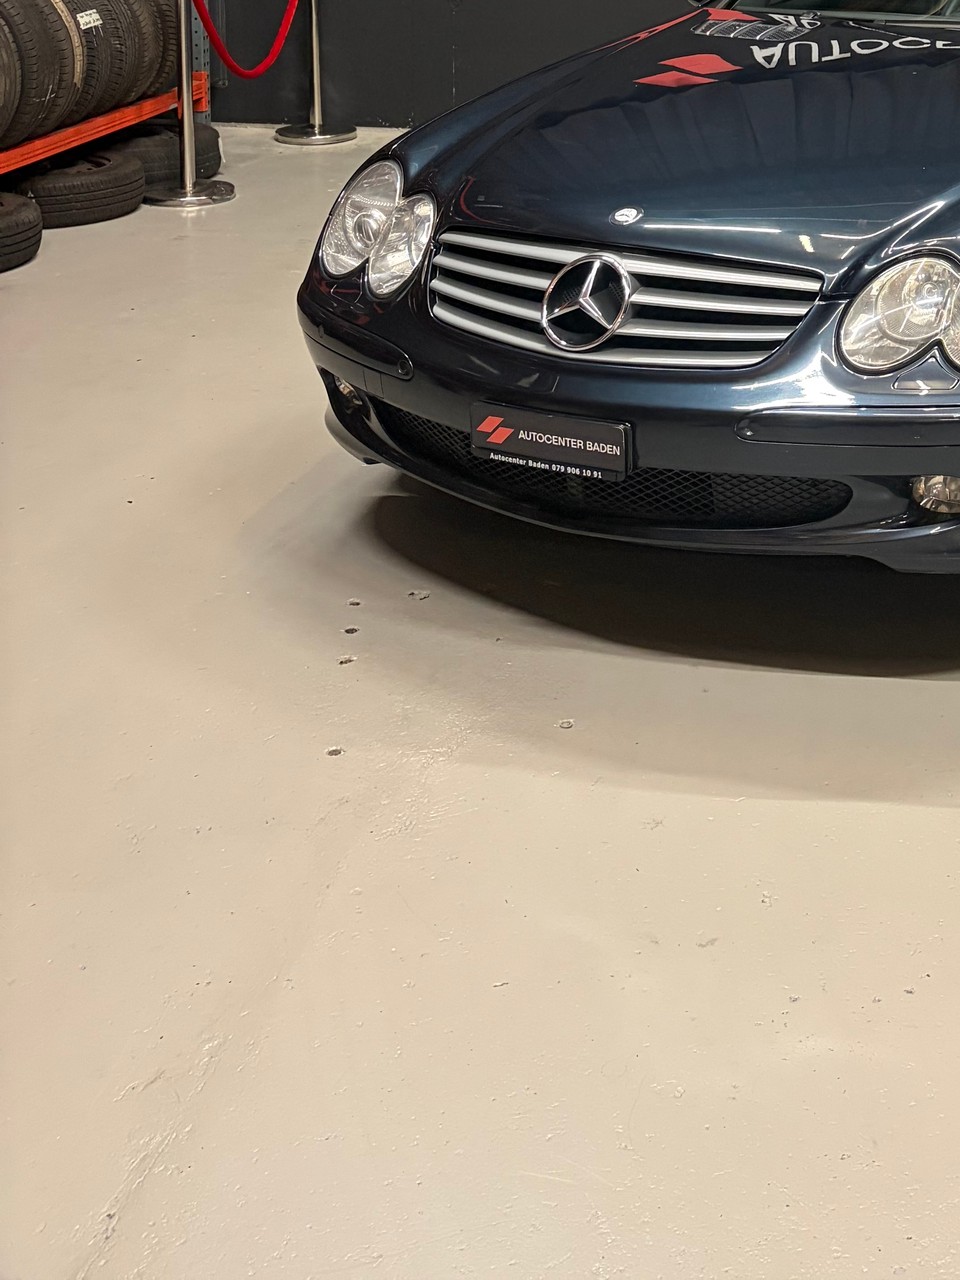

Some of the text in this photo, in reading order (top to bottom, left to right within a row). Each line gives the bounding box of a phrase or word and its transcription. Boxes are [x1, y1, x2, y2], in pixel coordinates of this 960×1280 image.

[518, 430, 620, 456] AUTOCENTER BADEN
[490, 452, 526, 465] Autocenter
[528, 460, 549, 470] Baden
[582, 469, 591, 477] 10
